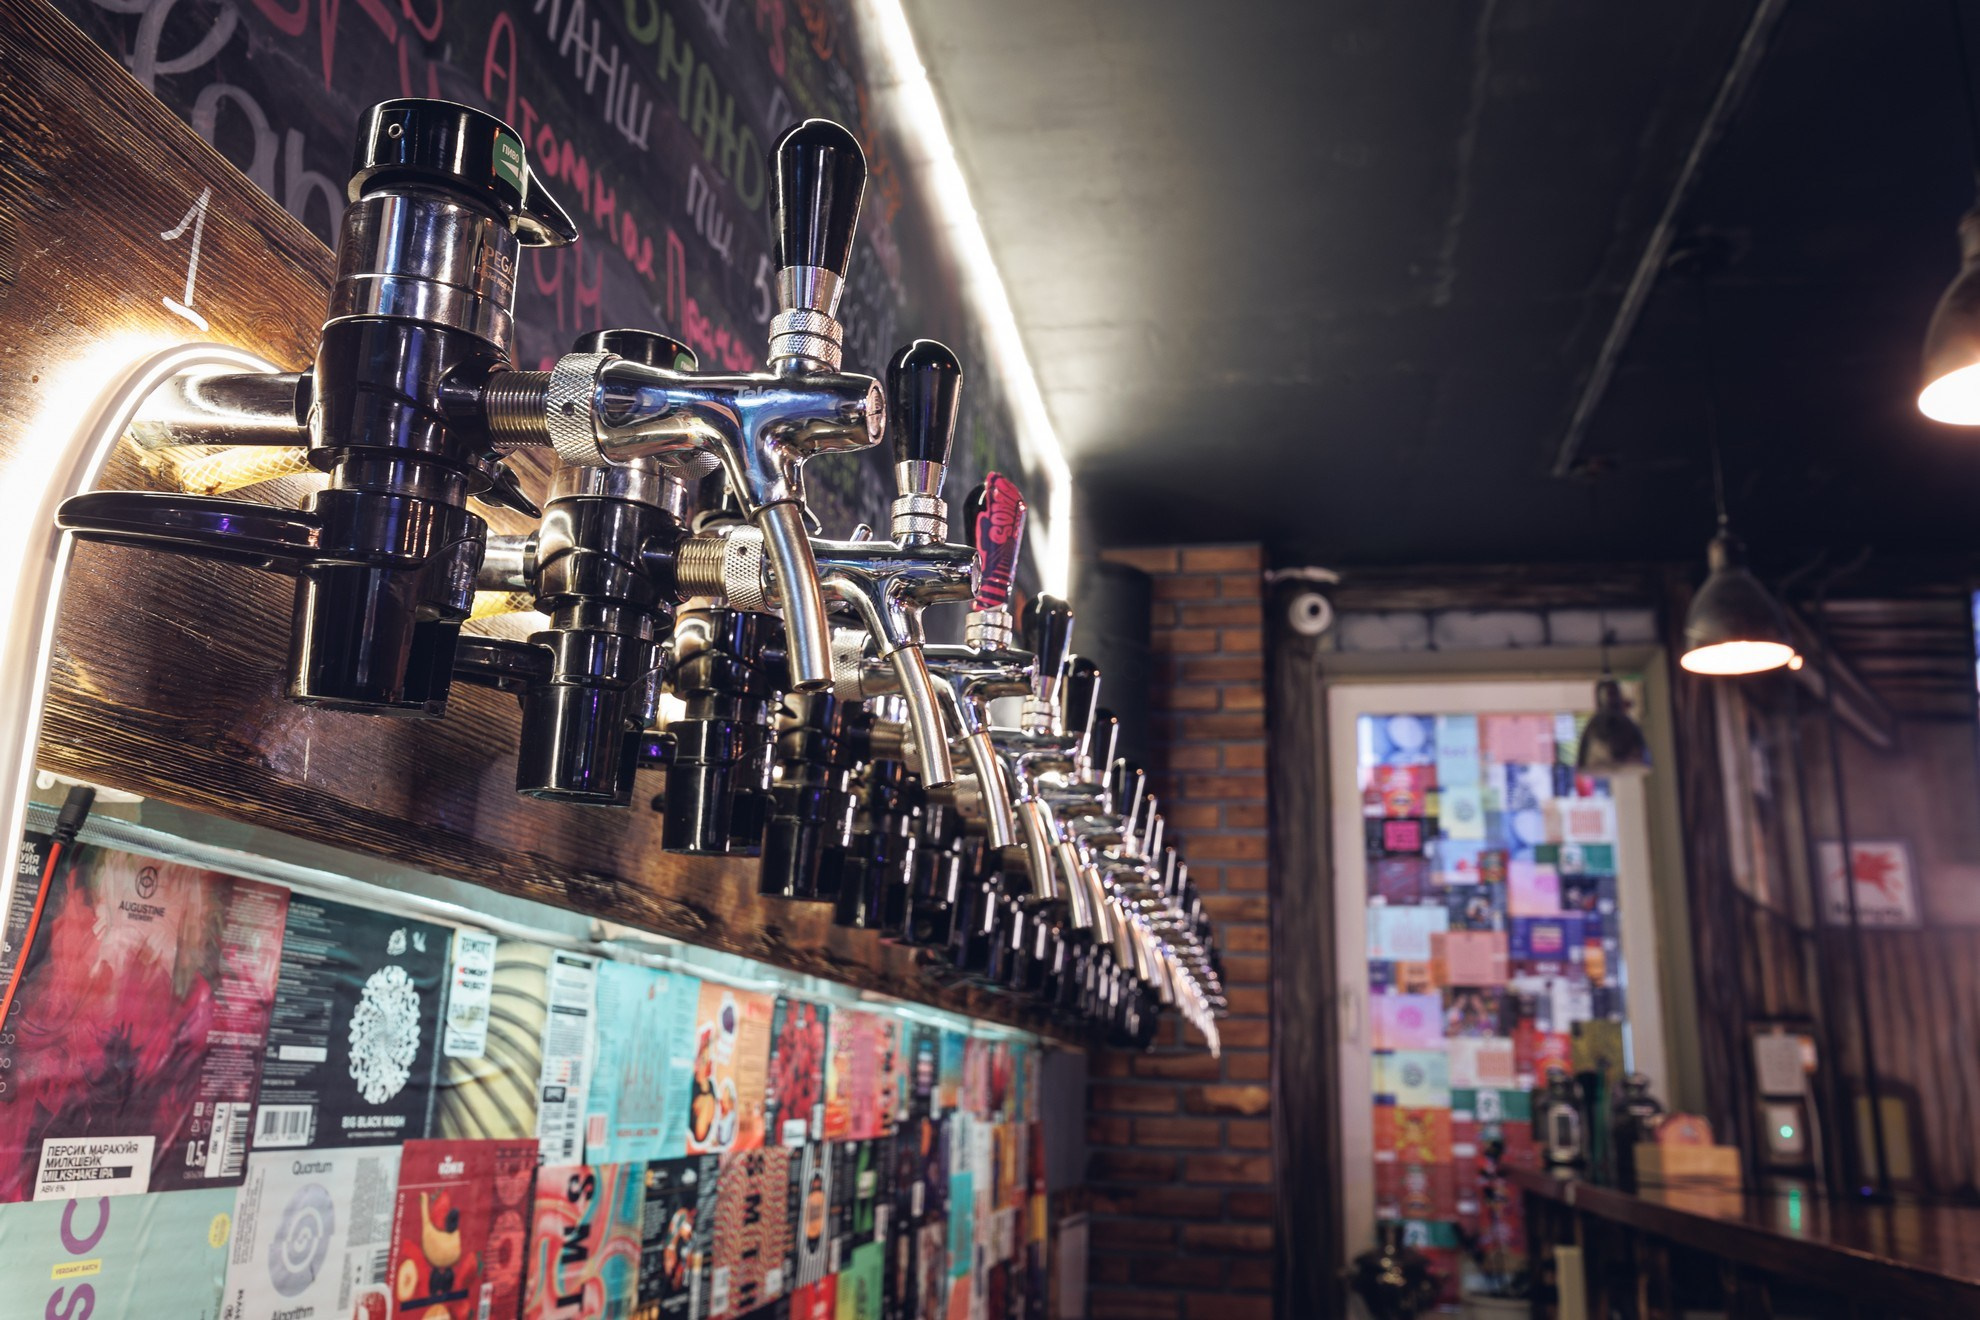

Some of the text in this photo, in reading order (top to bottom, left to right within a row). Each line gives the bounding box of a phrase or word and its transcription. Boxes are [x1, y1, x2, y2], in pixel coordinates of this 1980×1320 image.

[118, 900, 166, 918] AUGUSTINE
[47, 1140, 139, 1157] ПЕРСИК МАРАКУЙЯ
[44, 1154, 103, 1169] МИЛКШЕЙК
[292, 1160, 333, 1176] Quantum
[41, 1167, 114, 1182] MILKSHAKE IPA
